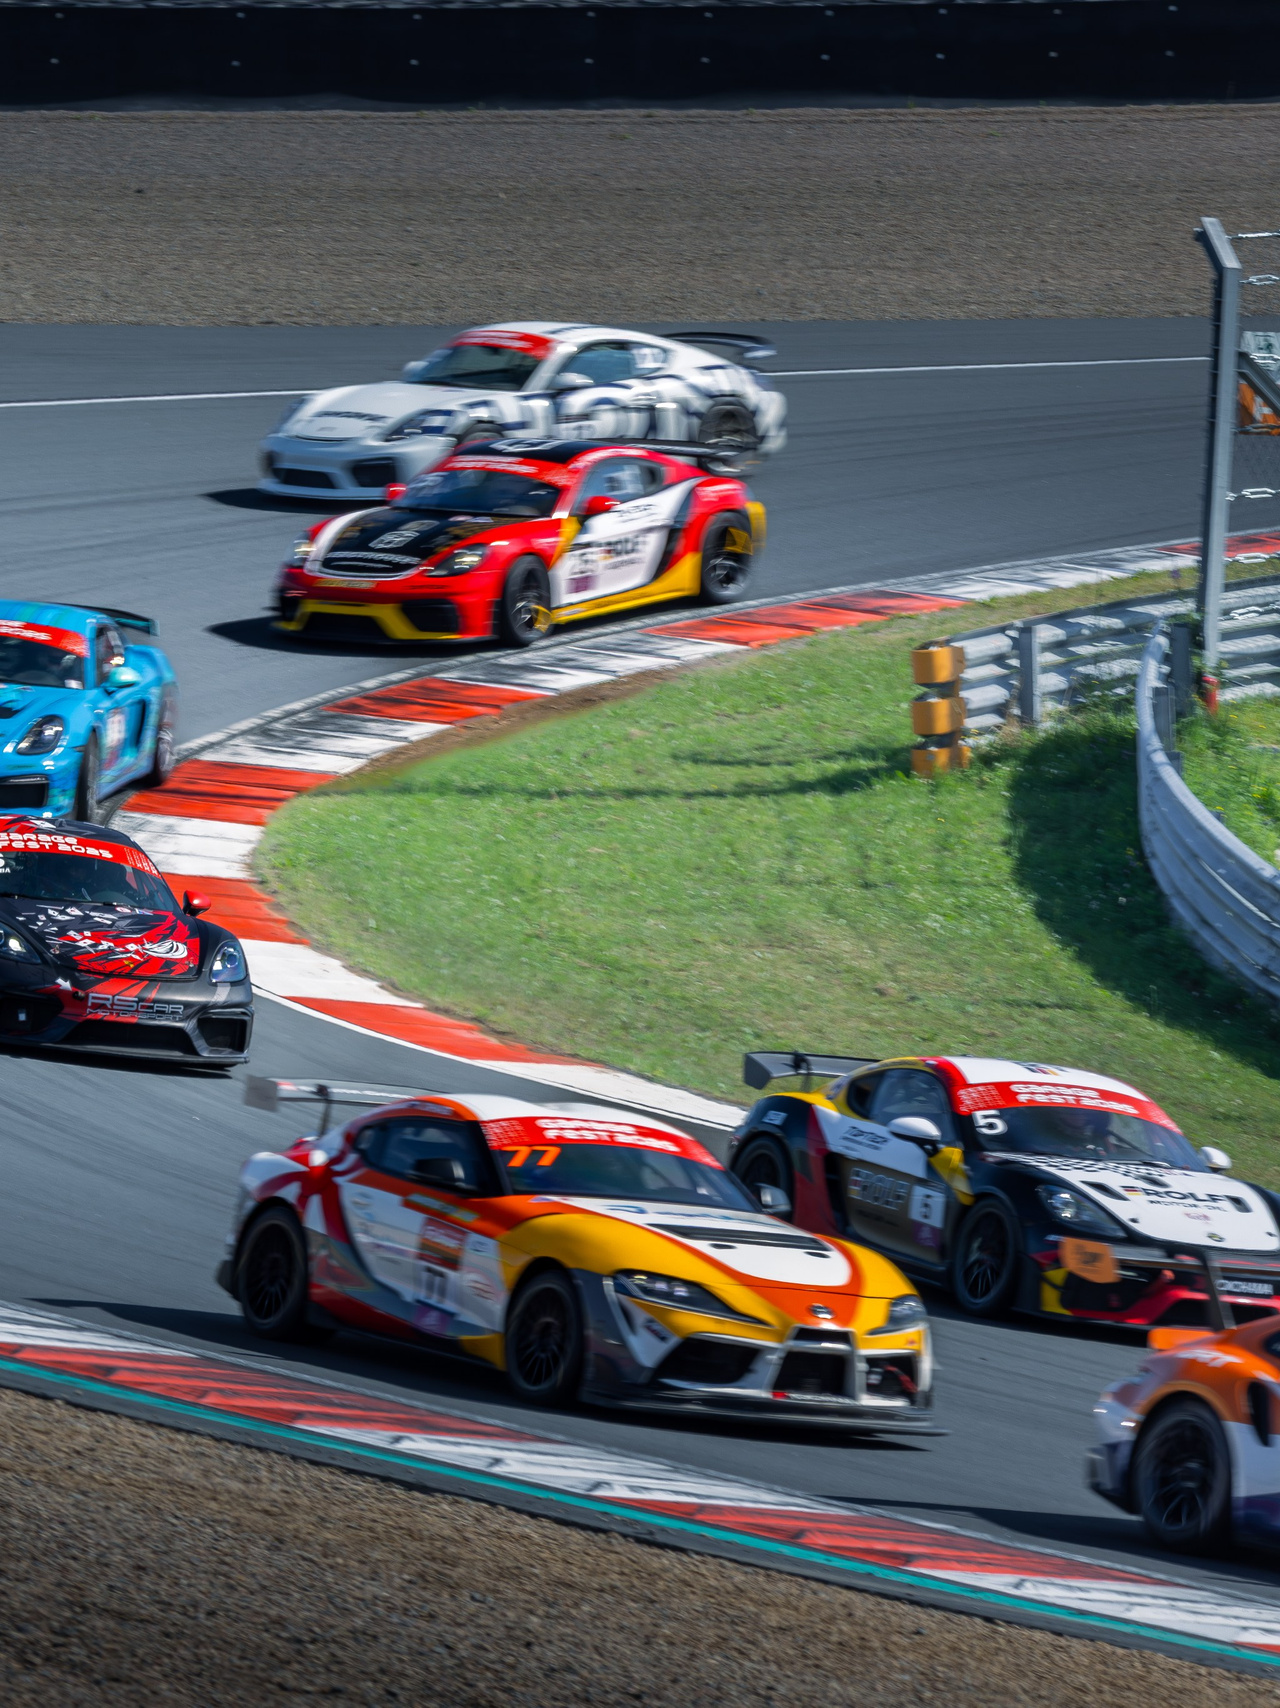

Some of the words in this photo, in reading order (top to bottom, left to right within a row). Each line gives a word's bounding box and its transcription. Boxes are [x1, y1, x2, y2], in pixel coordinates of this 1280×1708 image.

[58, 844, 113, 859] 2025
[87, 1008, 183, 1021] MOTORSPORT
[1079, 1098, 1139, 1114] 2025
[972, 1109, 1008, 1135] 5
[613, 1133, 681, 1152] 2025
[501, 1145, 561, 1167] 77
[860, 1168, 910, 1210] ROLF
[1141, 1187, 1228, 1203] ROLF
[921, 1193, 932, 1219] 5
